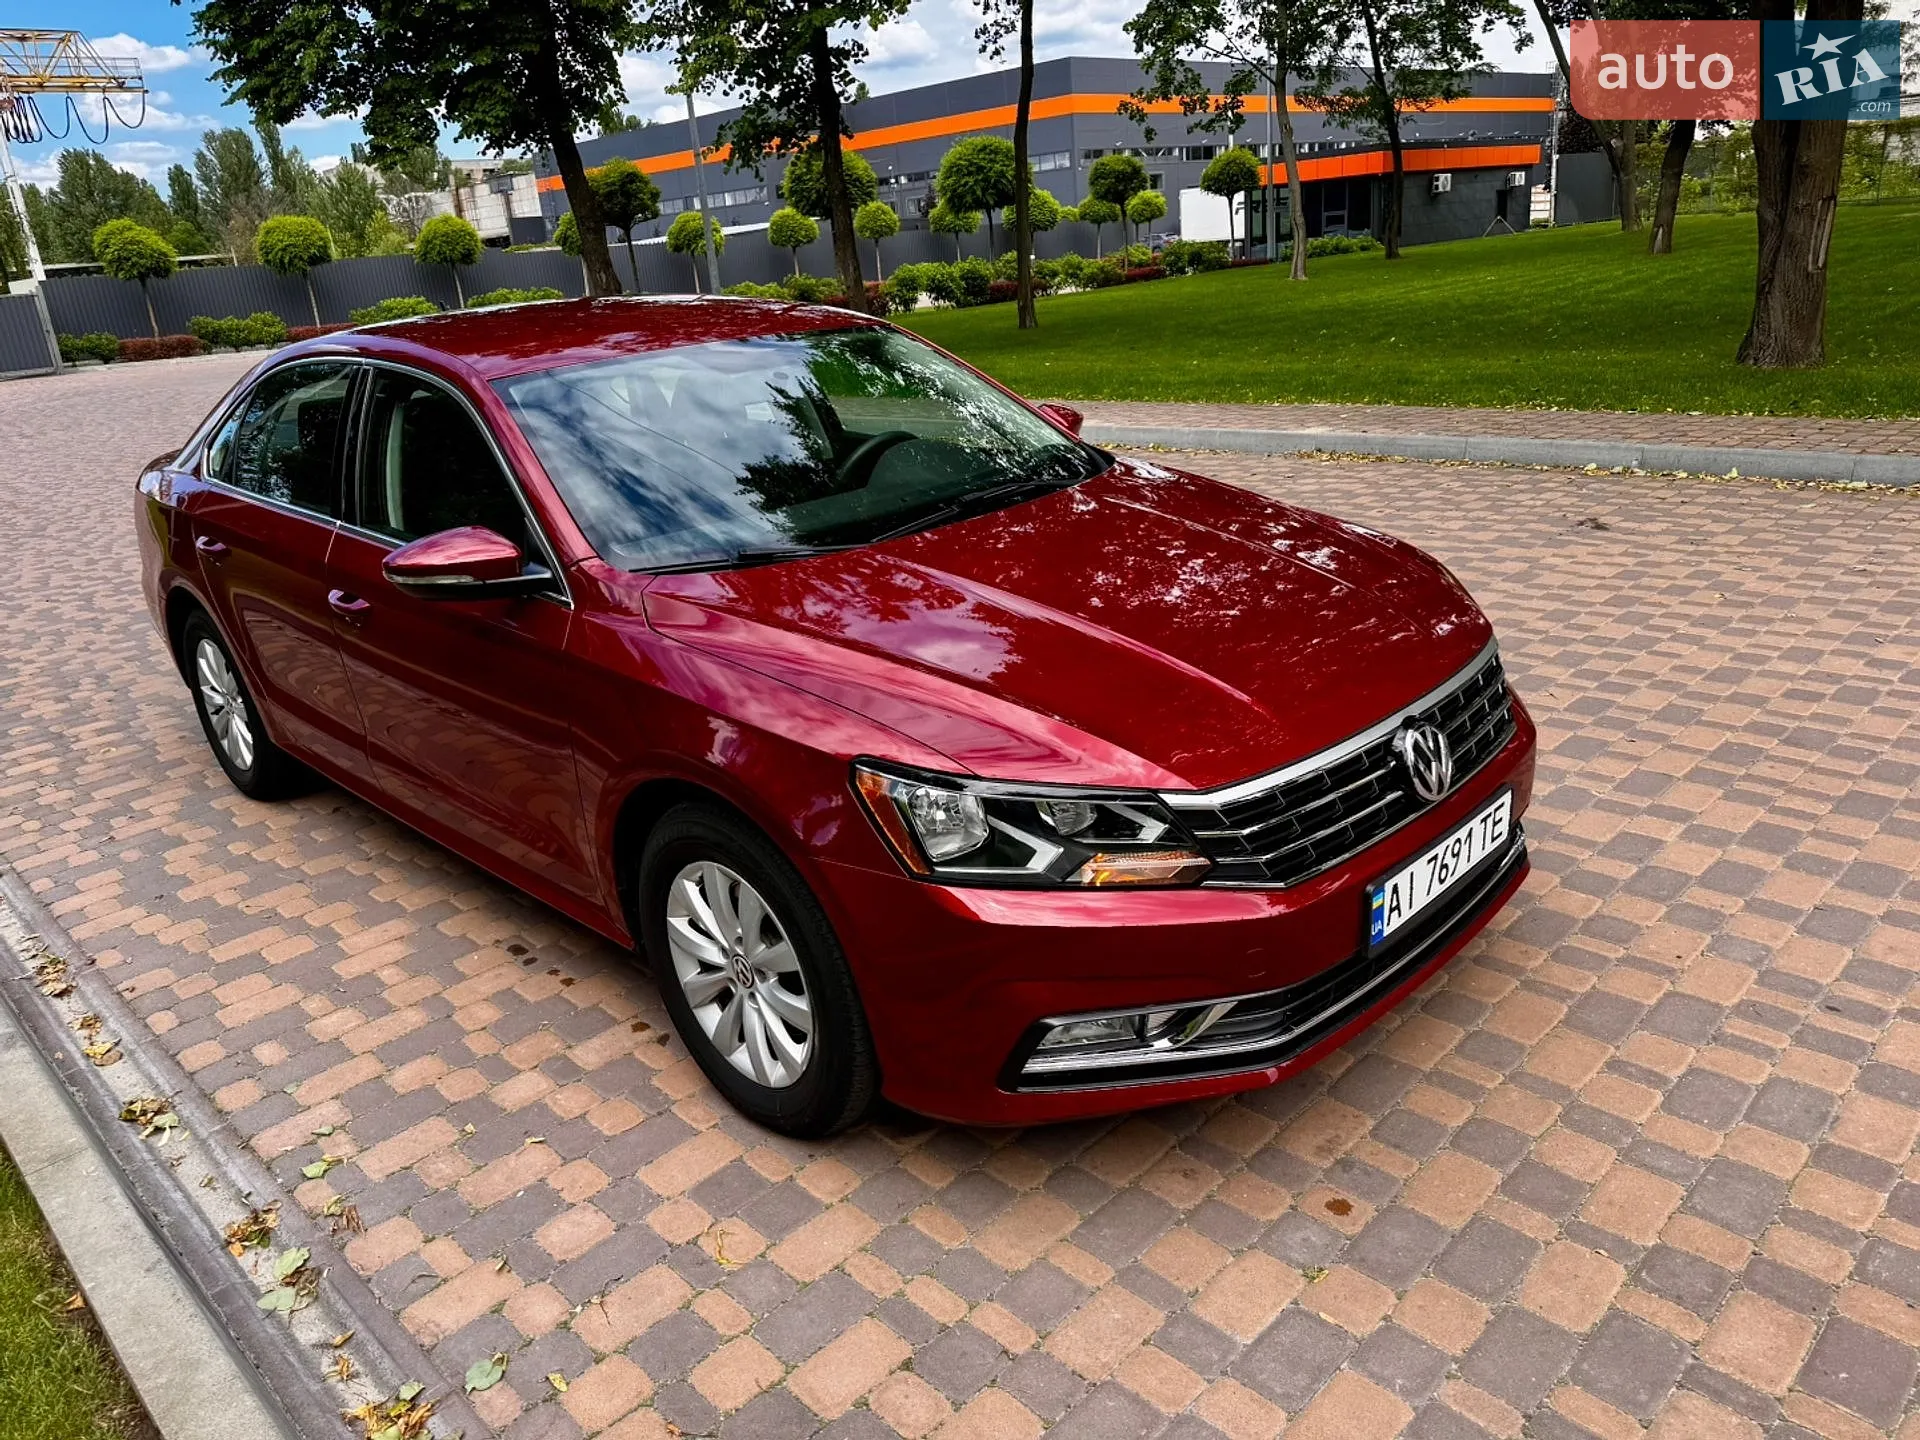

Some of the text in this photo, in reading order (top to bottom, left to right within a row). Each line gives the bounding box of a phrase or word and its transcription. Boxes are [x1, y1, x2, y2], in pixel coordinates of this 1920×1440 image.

[1386, 802, 1506, 926] AI 7691 TE
[1371, 919, 1383, 936] UA
